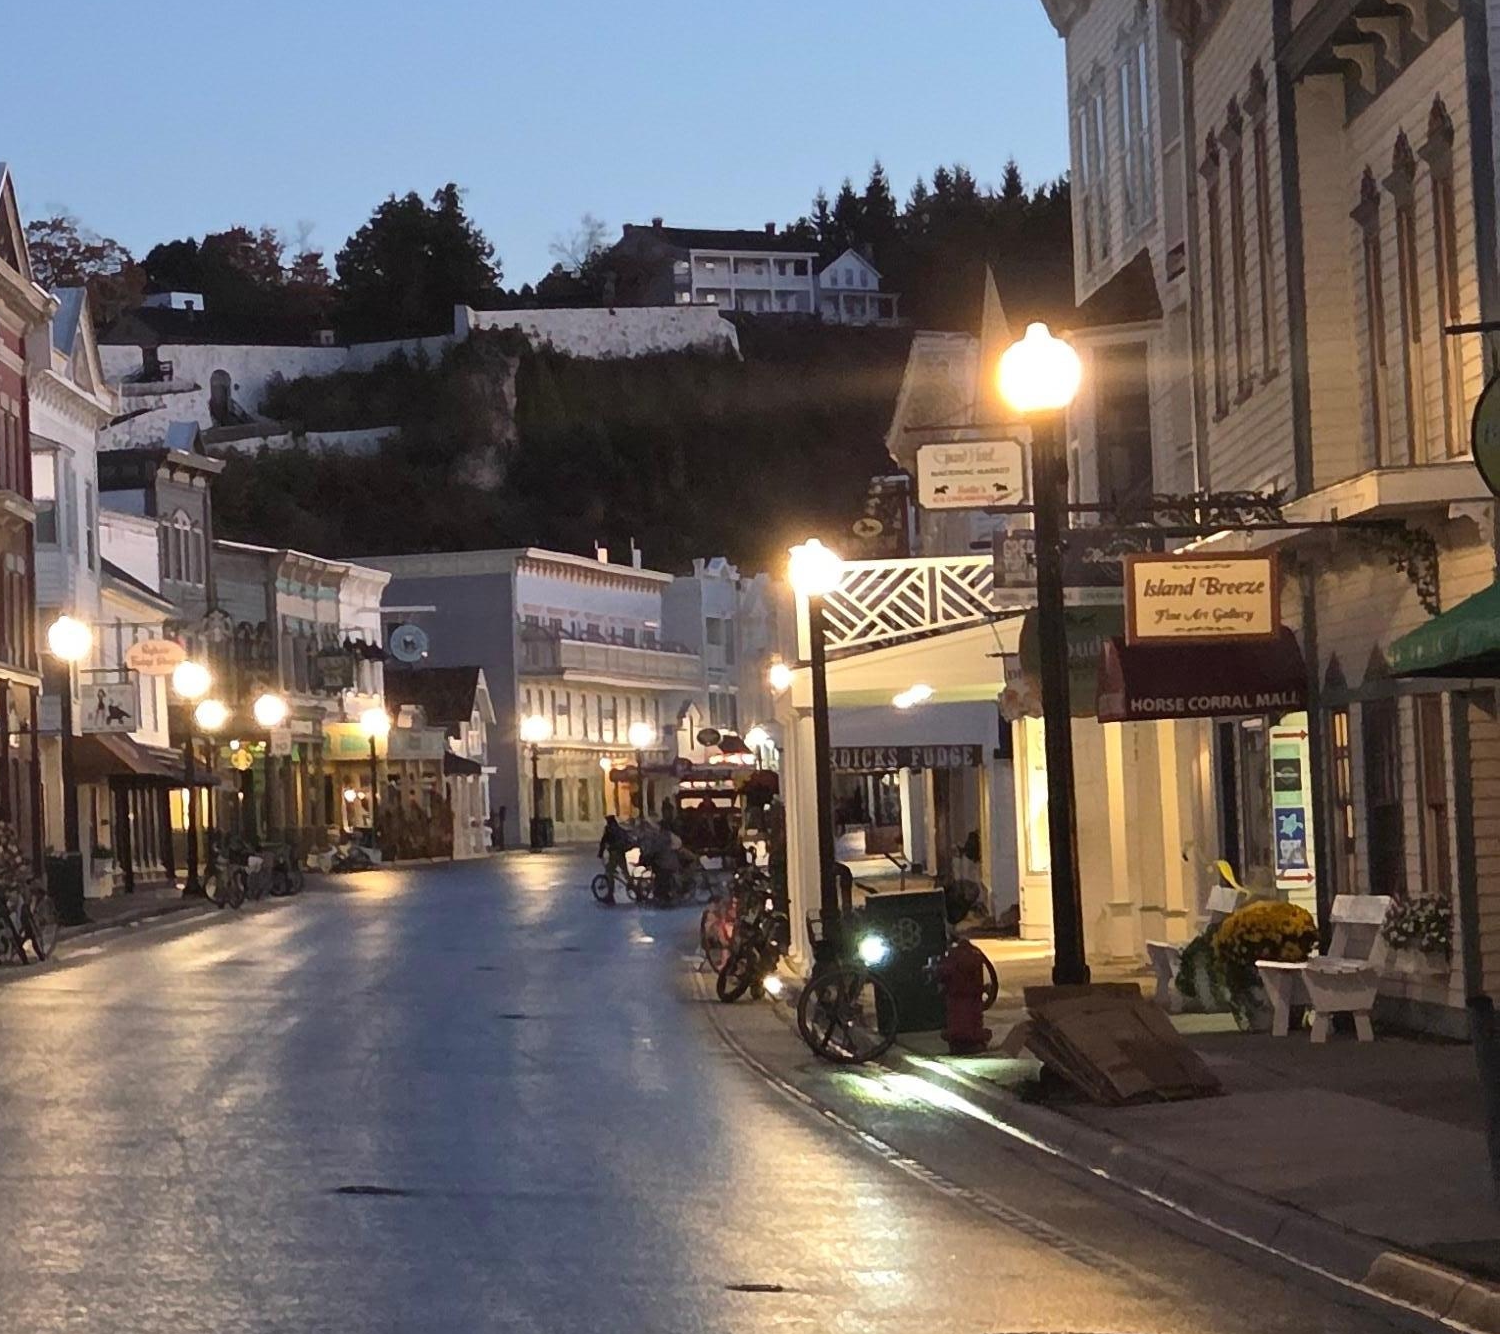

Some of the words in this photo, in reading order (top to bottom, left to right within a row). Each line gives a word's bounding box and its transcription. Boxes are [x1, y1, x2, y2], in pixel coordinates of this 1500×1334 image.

[1143, 578, 1196, 597] Island
[1200, 576, 1265, 596] Breeze
[1154, 608, 1181, 624] Fine
[1184, 608, 1209, 621] Art
[1212, 607, 1254, 623] Gallery
[1131, 697, 1185, 712] HORSE
[1188, 694, 1253, 711] CORRAL
[1255, 690, 1301, 708] MALL
[829, 746, 899, 768] RDICKS
[911, 745, 974, 767] FUDGE
